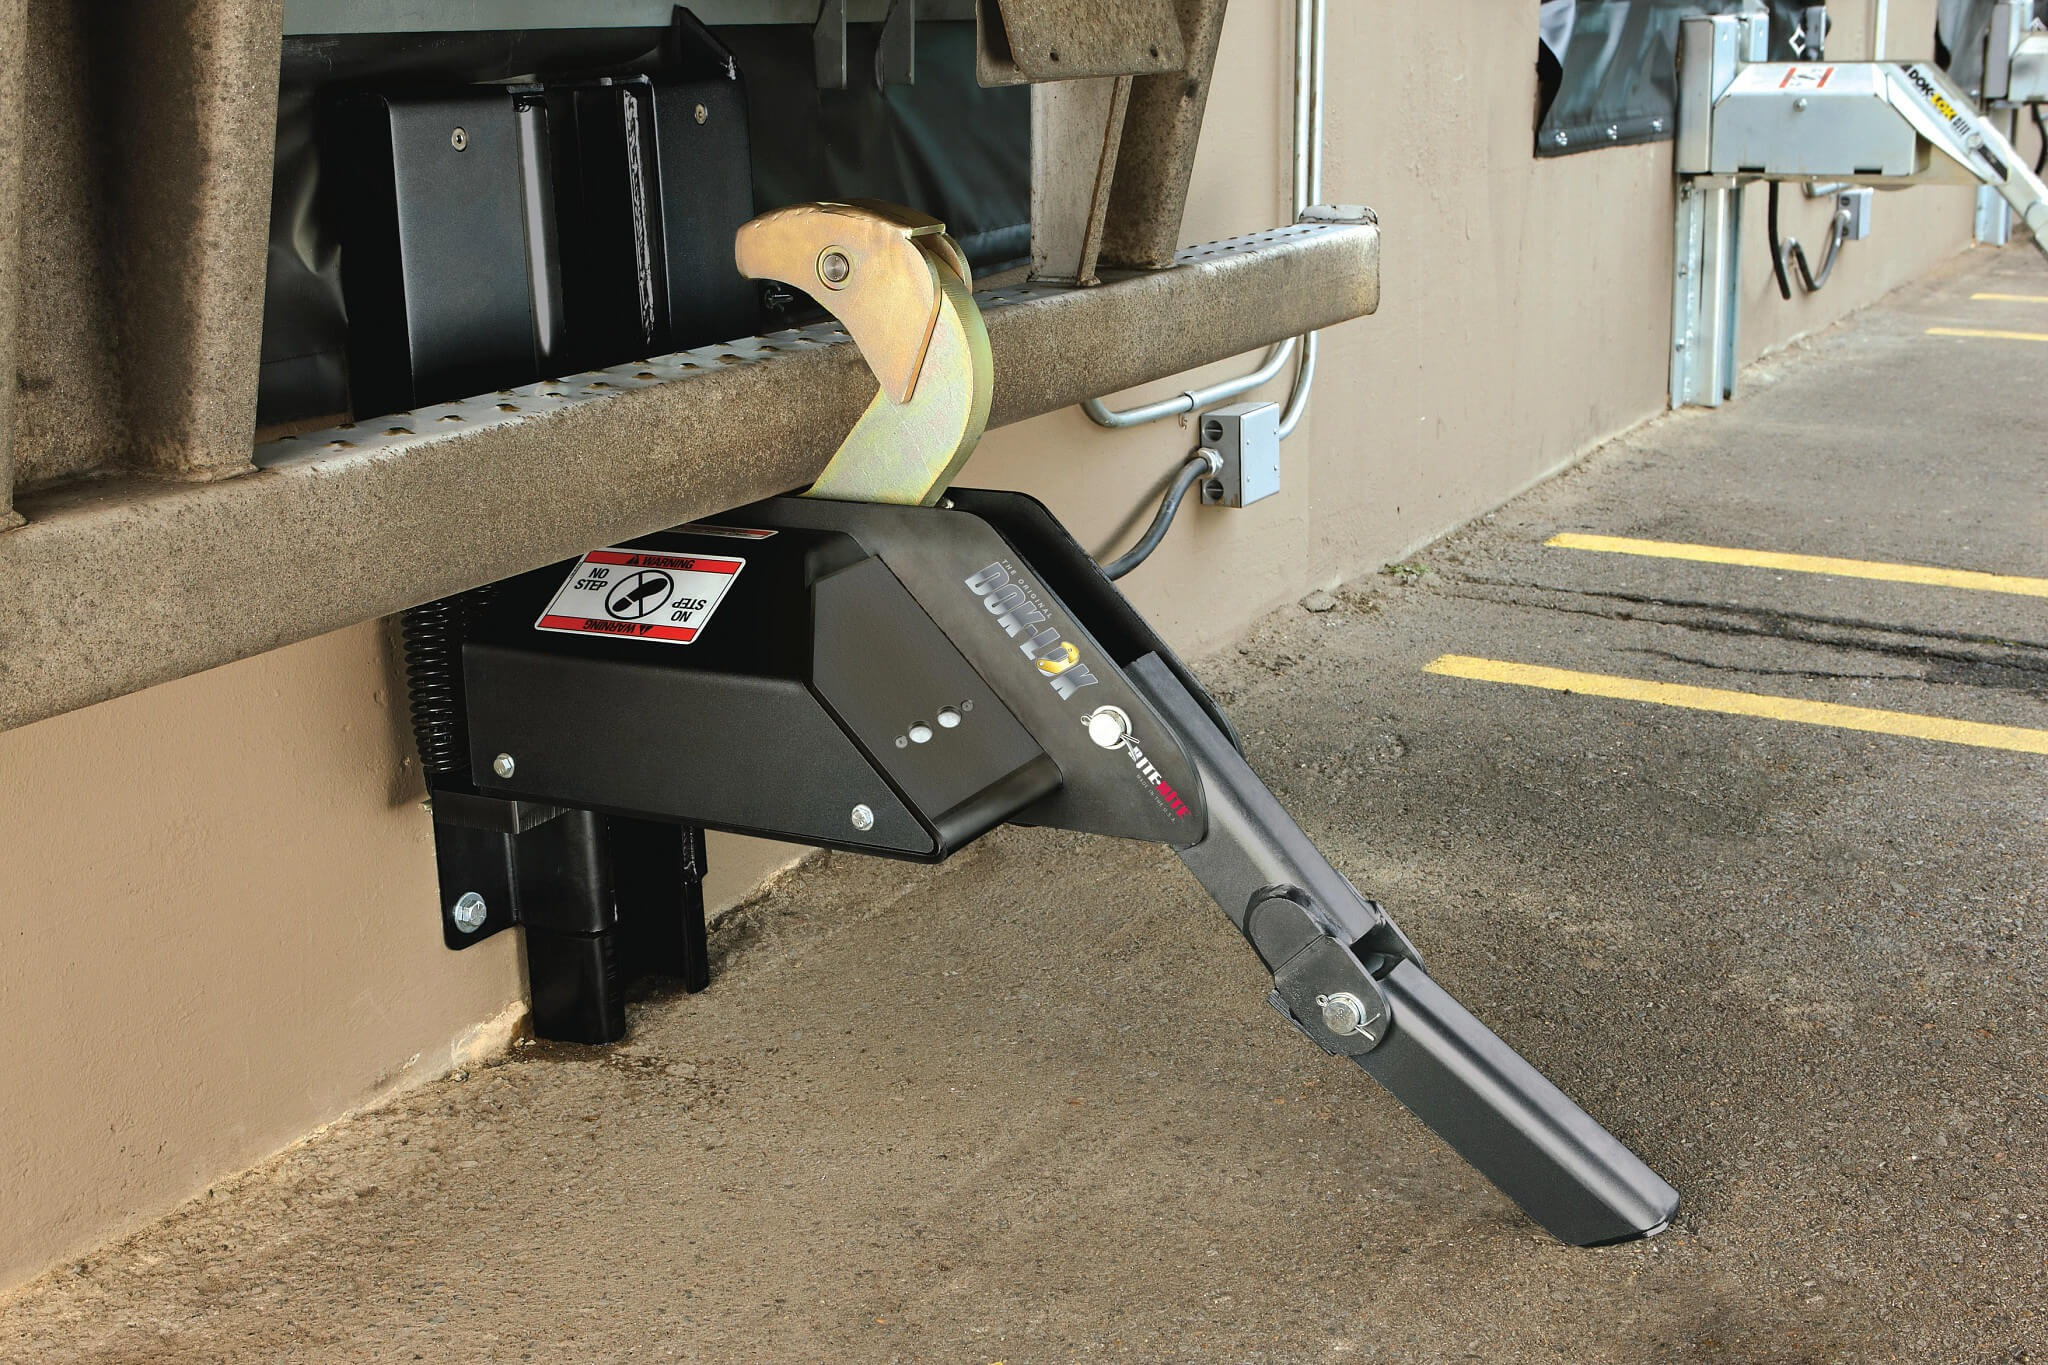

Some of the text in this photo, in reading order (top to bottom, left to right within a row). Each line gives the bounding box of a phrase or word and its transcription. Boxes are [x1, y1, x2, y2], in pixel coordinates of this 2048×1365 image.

[1908, 69, 1958, 122] DOK-LOK
[641, 556, 697, 569] WARNING
[588, 567, 609, 579] NO
[574, 579, 608, 591] STEP
[1002, 559, 1053, 619] THE ORIGINAL
[672, 598, 707, 610] STEP
[671, 610, 692, 622] NO
[583, 619, 636, 632] WARNING
[964, 561, 1099, 702] DOK-LOK
